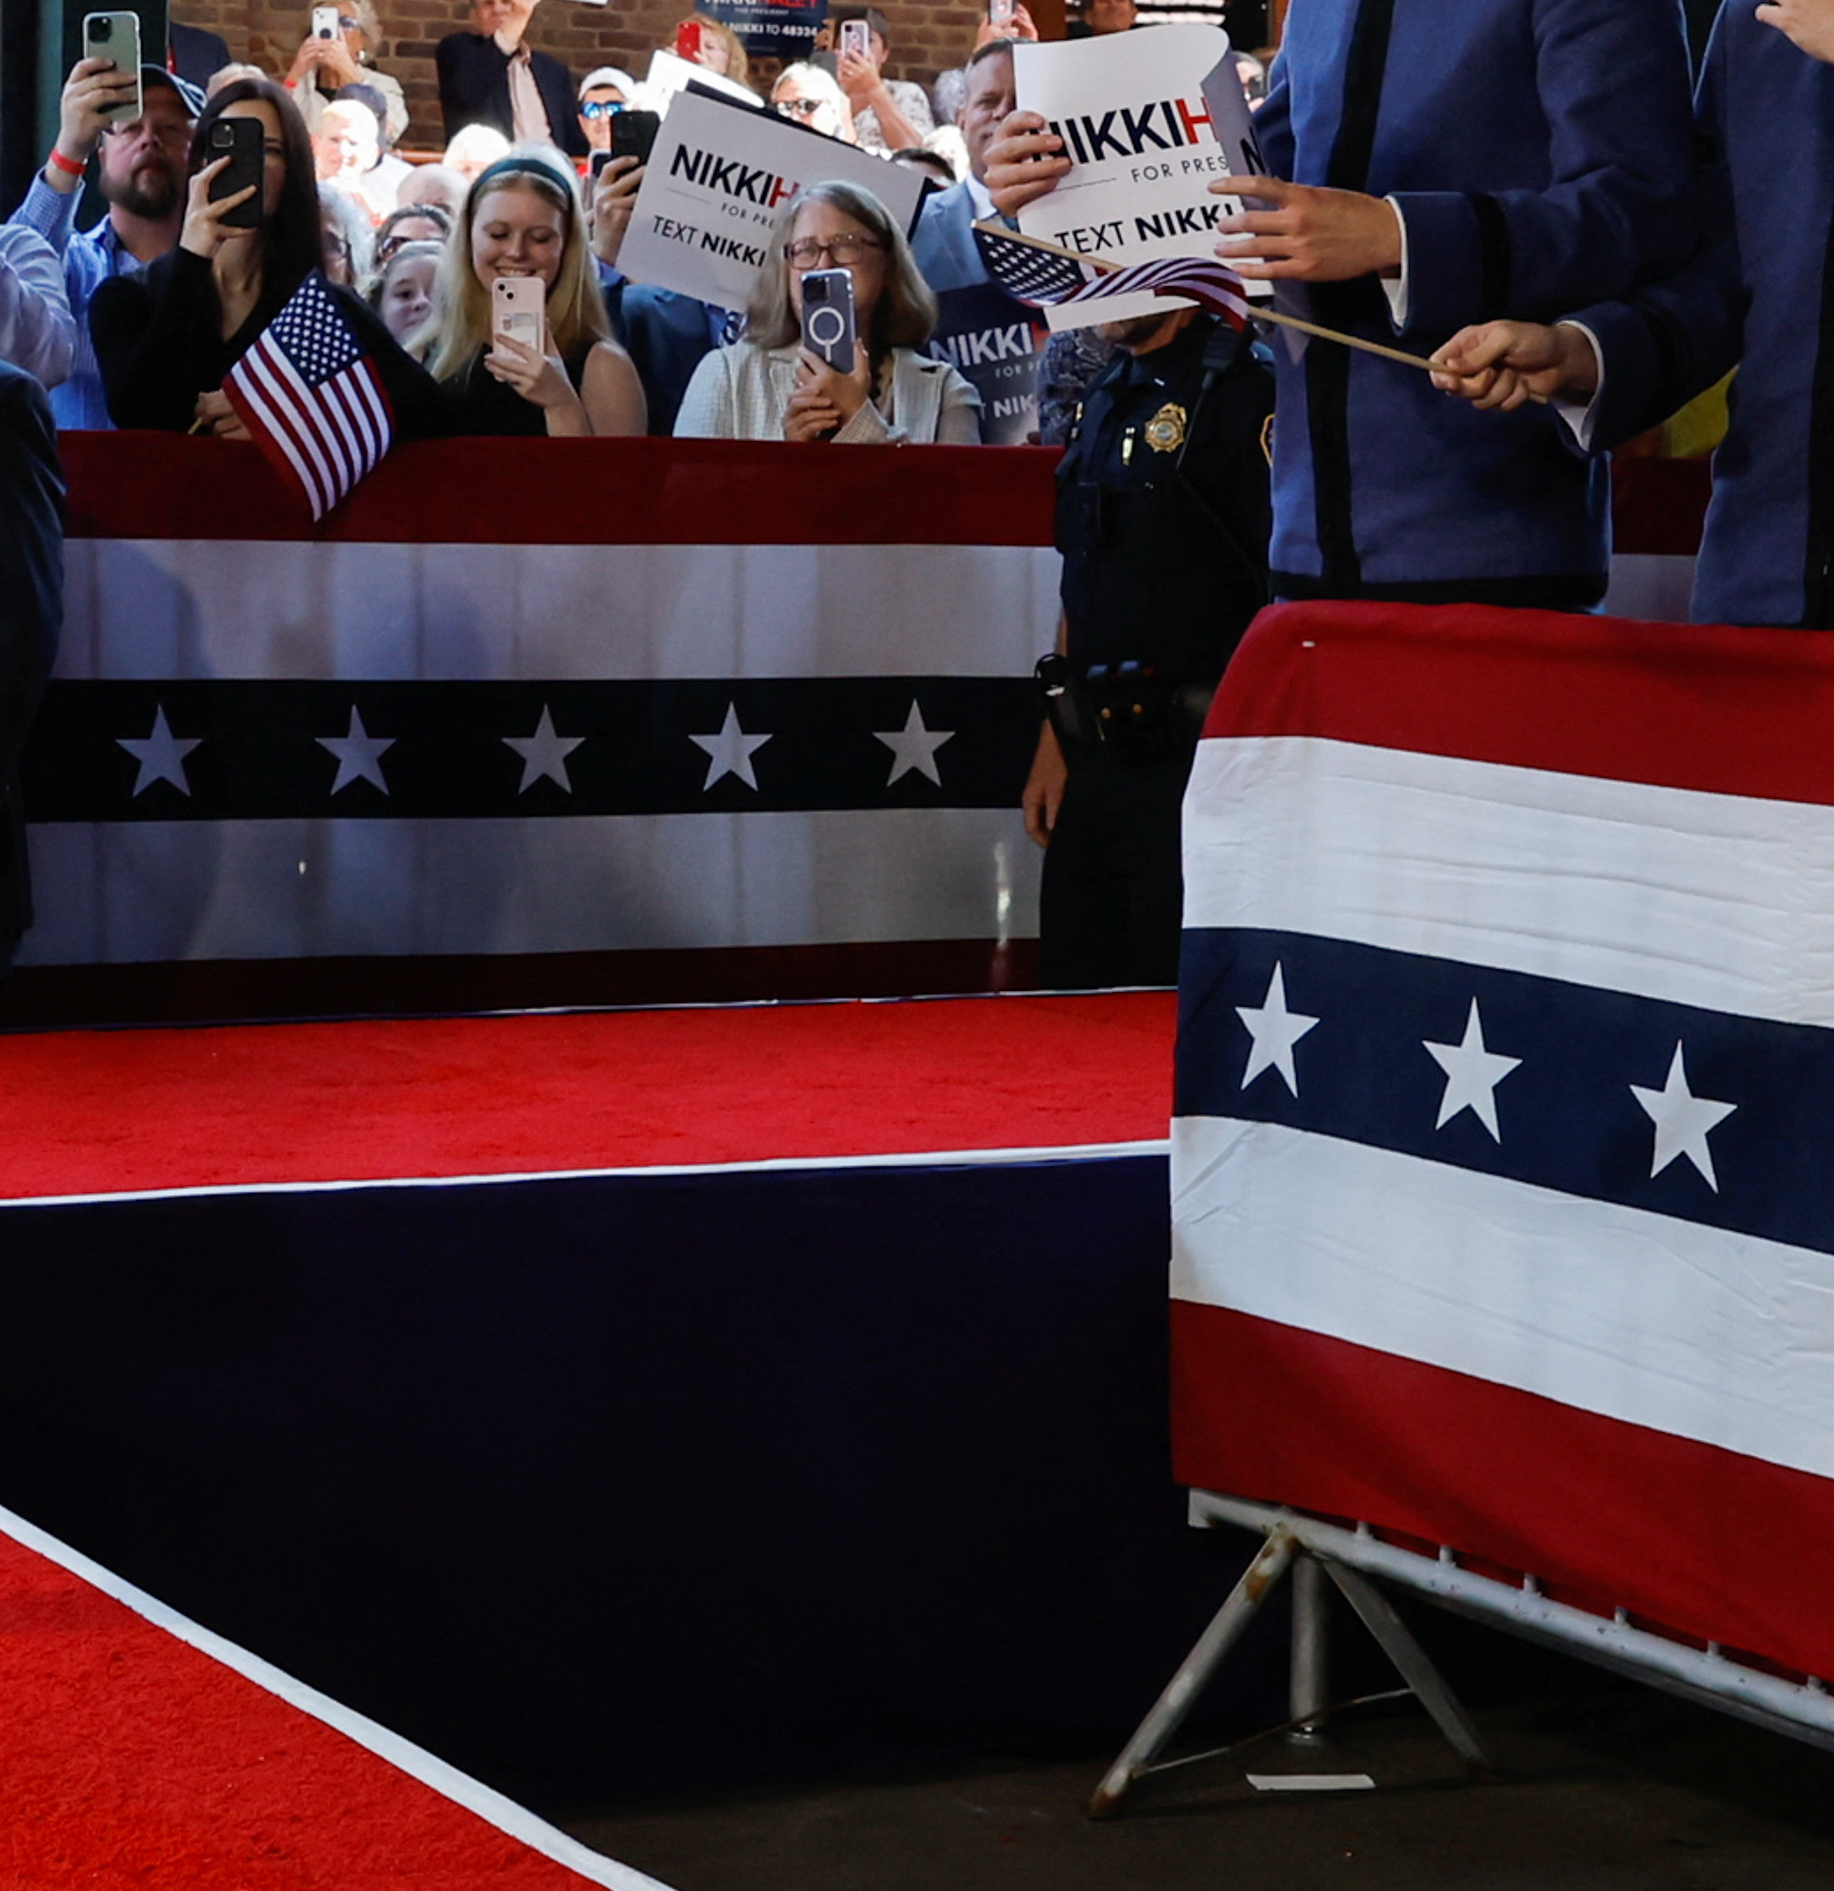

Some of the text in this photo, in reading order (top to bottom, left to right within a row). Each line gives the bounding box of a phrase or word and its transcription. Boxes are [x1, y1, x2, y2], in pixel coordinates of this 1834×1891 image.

[1131, 163, 1173, 183] FOR
[721, 203, 747, 219] FOR
[652, 215, 767, 268] TEXT NIKKI
[1055, 221, 1124, 253] TEXT
